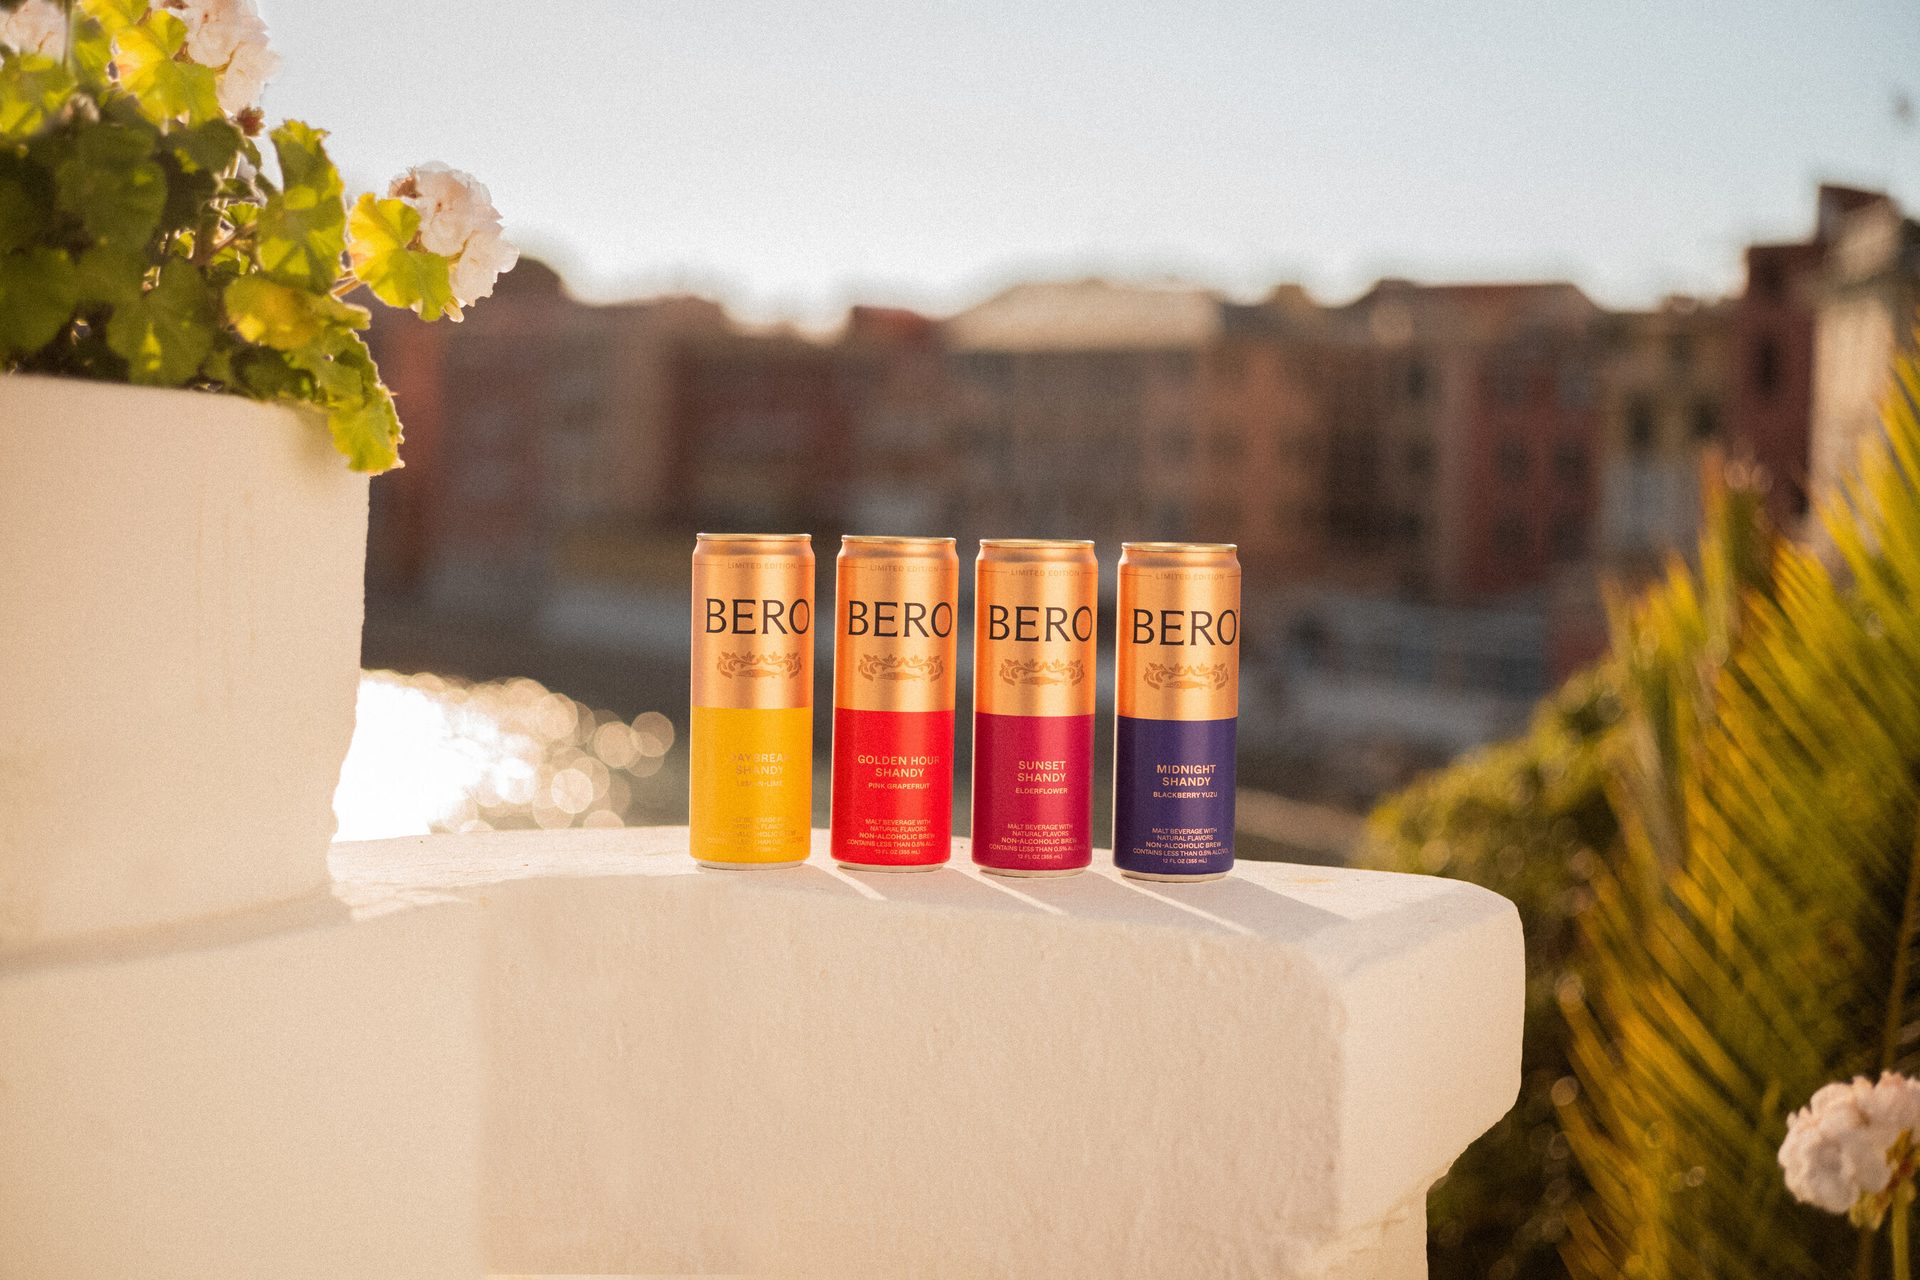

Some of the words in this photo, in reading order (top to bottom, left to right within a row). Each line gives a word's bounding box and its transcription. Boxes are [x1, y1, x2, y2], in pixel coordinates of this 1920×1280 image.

[728, 562, 761, 570] LIMITED
[1011, 569, 1044, 577] LIMITED
[705, 598, 810, 634] BERO
[848, 600, 953, 638] BERO
[989, 604, 1093, 642] BERO
[1132, 608, 1238, 646] BERO
[857, 755, 907, 766] GOLDEN
[910, 756, 940, 766] HOUR
[1018, 760, 1066, 770] SUNSET
[875, 768, 925, 777] SHANDY
[1156, 764, 1216, 774] MIDNIGHT
[1017, 773, 1066, 782] SHANDY
[1162, 777, 1211, 786] SHANDY
[1153, 791, 1200, 799] BLACKBERRY
[859, 832, 918, 840] NON-ALCOHOLIC
[989, 843, 1018, 852] CONTAINS
[1145, 841, 1205, 849] NON-ALCOHOLIC
[1132, 847, 1163, 856] CONTAINS
